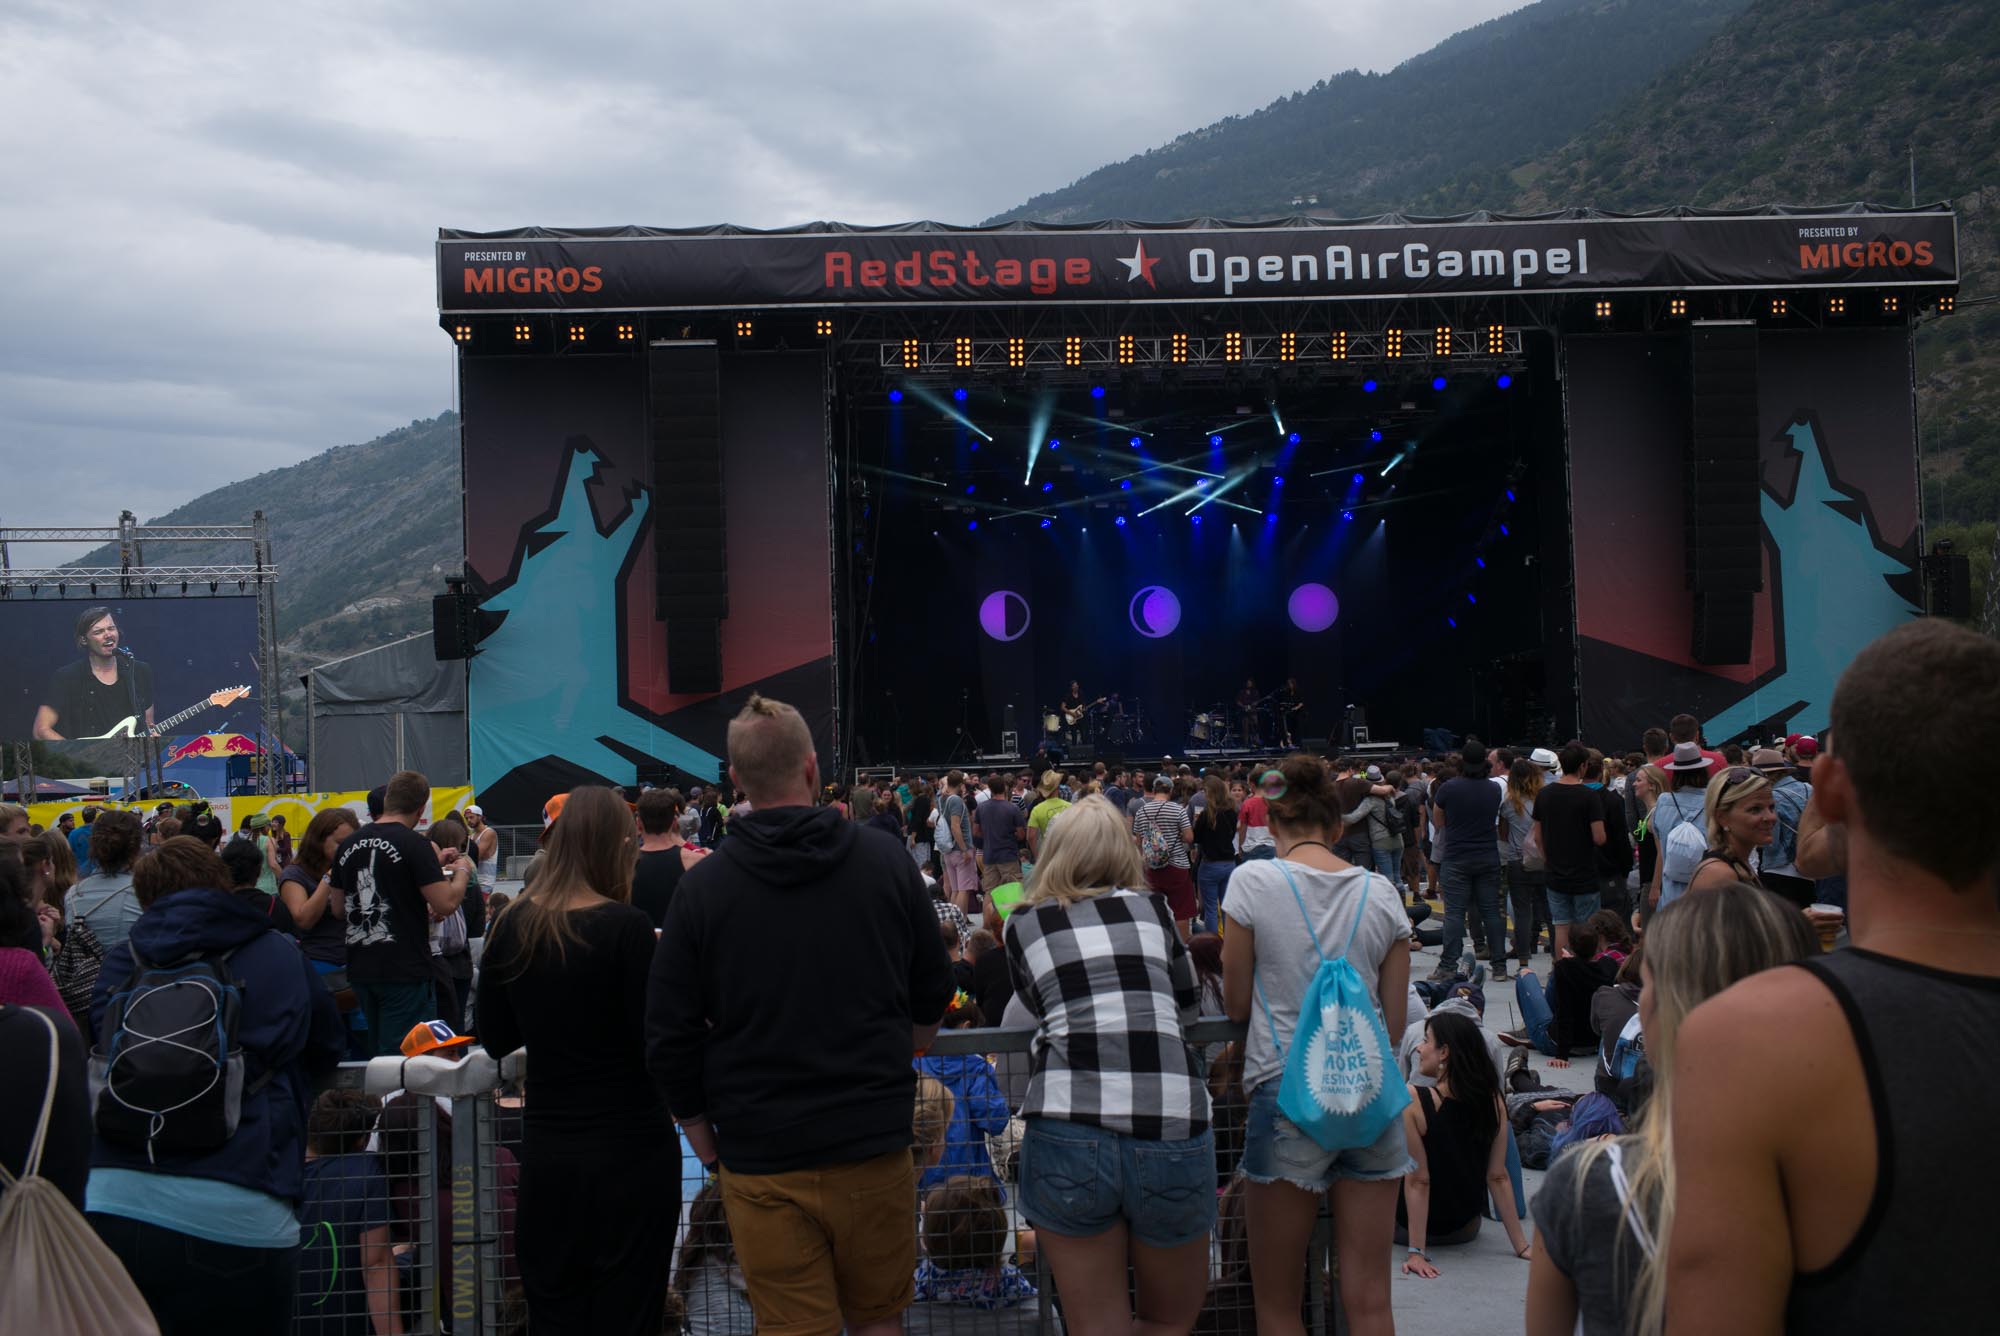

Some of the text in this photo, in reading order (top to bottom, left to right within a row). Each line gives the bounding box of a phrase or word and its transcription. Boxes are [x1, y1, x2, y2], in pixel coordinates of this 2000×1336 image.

[1799, 226, 1858, 237] PRESENTED BY
[464, 251, 527, 261] PRESENTED BY
[1189, 239, 1588, 295] OpenAirGampel
[1800, 240, 1934, 270] MIGROS
[464, 266, 603, 293] MIGROS
[825, 250, 1092, 294] RedStage
[338, 838, 403, 867] BEARTOOTH
